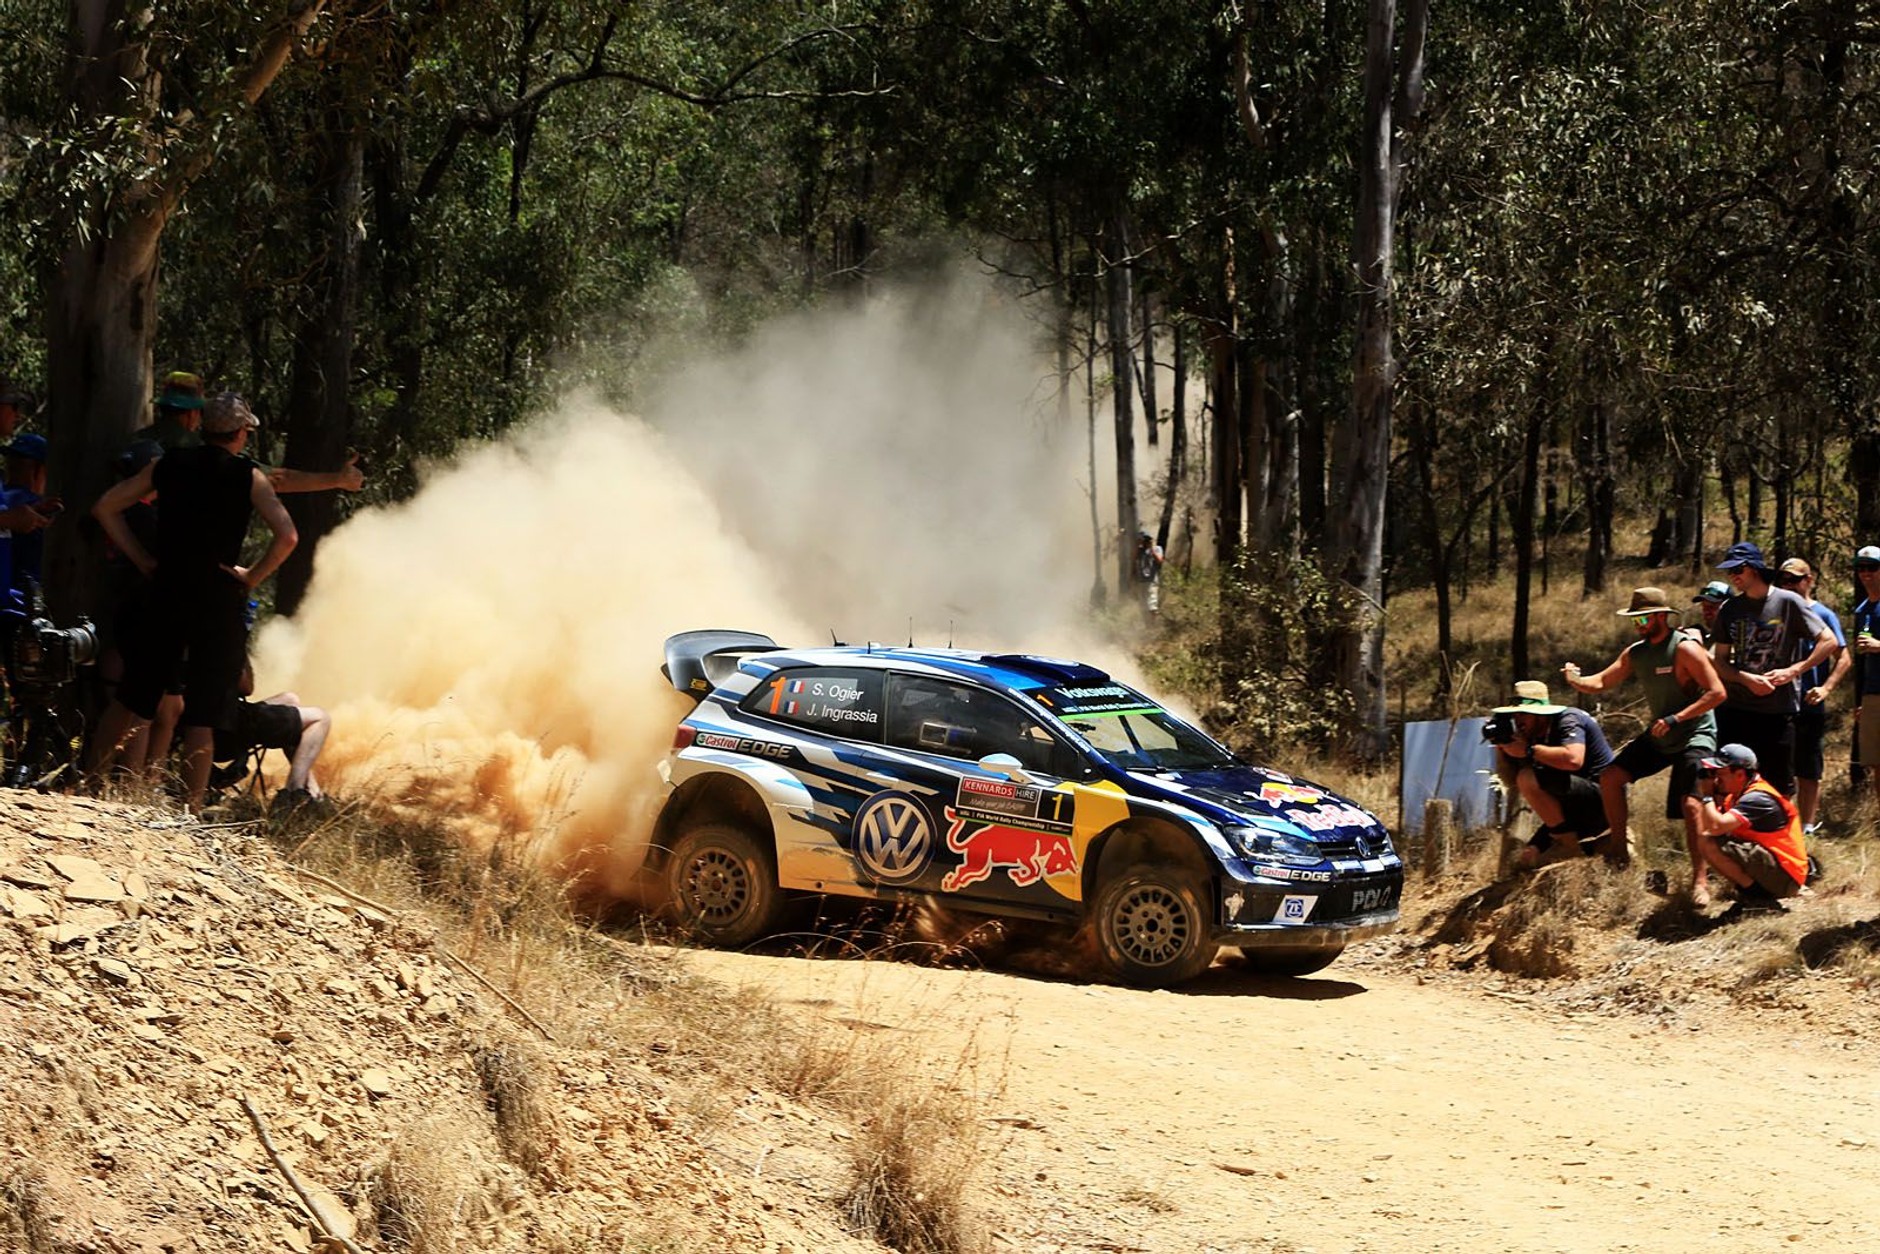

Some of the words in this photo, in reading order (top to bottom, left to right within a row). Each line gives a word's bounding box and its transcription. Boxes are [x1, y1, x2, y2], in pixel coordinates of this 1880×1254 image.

[770, 676, 786, 715] 1
[812, 683, 824, 696] S.
[828, 685, 864, 703] Ogier
[1036, 694, 1054, 707] 1
[806, 704, 817, 716] J.
[822, 705, 878, 723] Ingrassia
[705, 735, 738, 750] Castrol
[737, 739, 794, 759] EDGE
[964, 780, 1013, 797] KENNARDS
[1016, 788, 1035, 800] HIRE
[1052, 793, 1064, 820] 1
[1290, 869, 1332, 882] EDGE
